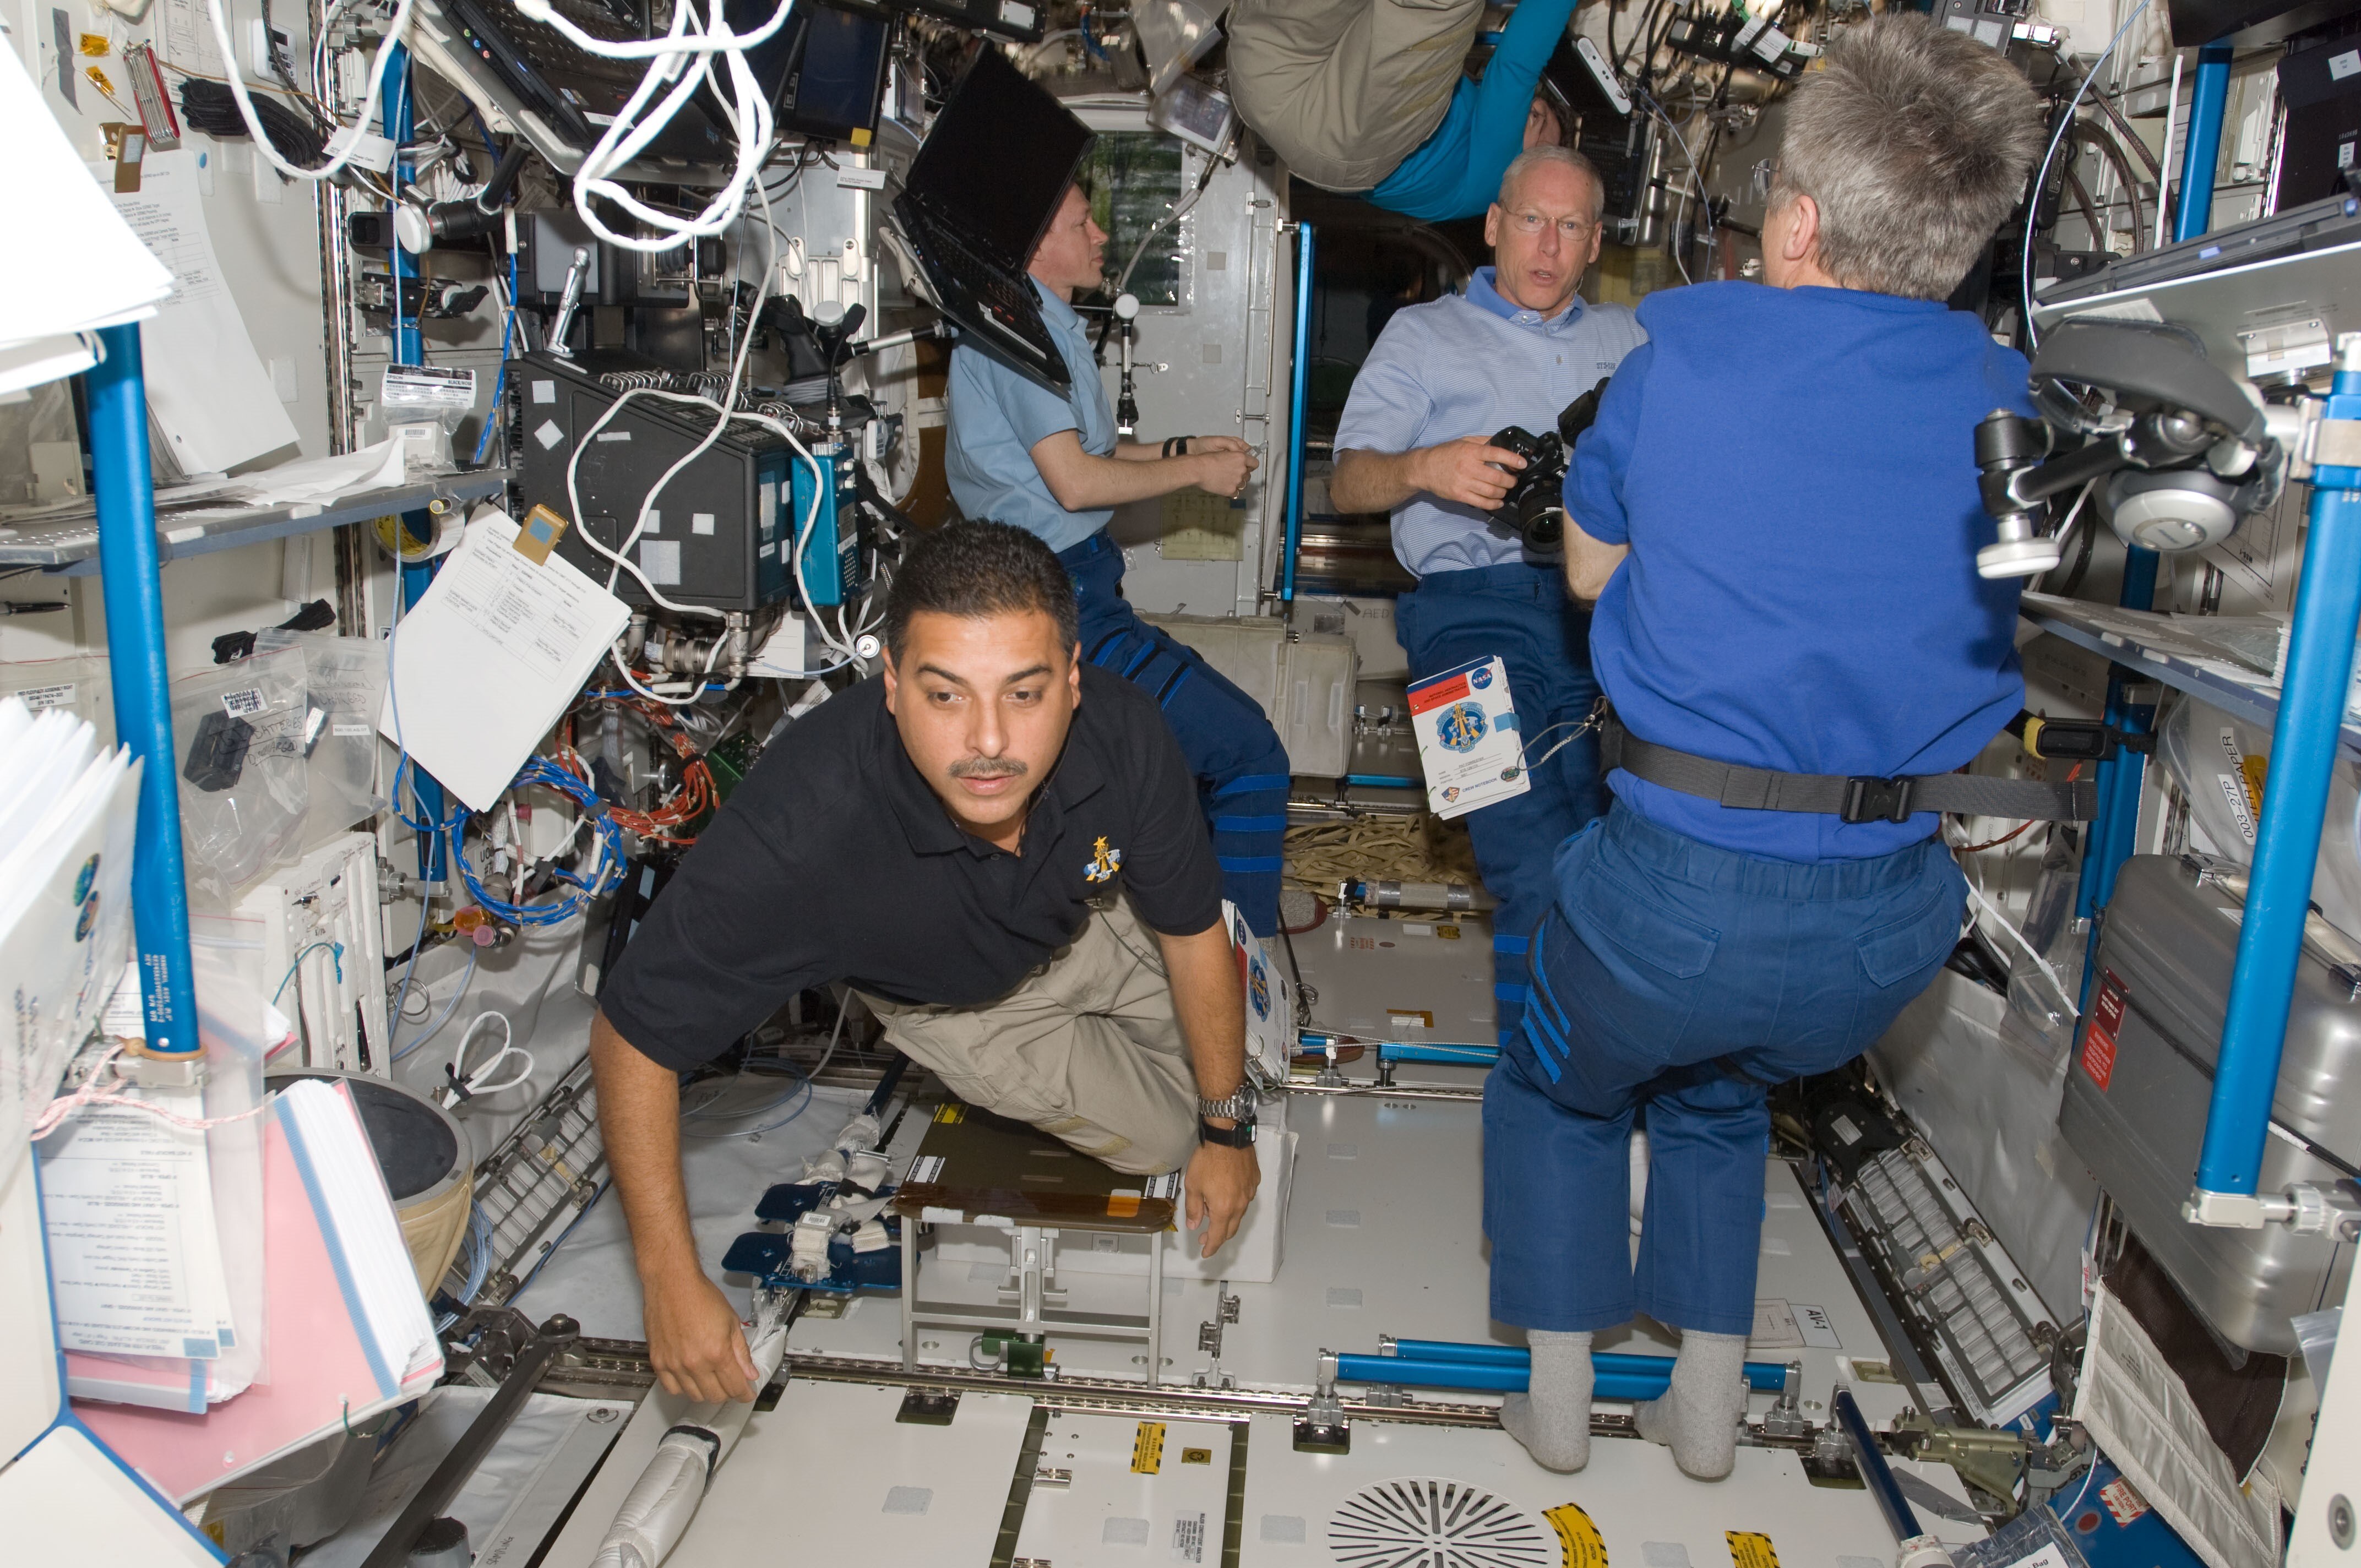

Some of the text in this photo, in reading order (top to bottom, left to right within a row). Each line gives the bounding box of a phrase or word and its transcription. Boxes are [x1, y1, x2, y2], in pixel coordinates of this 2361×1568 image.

[1362, 608, 1390, 618] AED
[1473, 673, 1492, 684] NASA
[253, 717, 302, 739] BATTERIES
[2222, 735, 2251, 786] PAPER
[1475, 777, 1498, 790] NOTEBOOK
[2223, 781, 2254, 838] 003-27P
[1806, 1309, 1829, 1329] AV-1
[2115, 1484, 2137, 1512] FIRE PORT
[486, 1537, 515, 1565] SAMPLING
[1588, 1542, 1597, 1560] CAUTION
[2032, 1558, 2049, 1568] Bag
